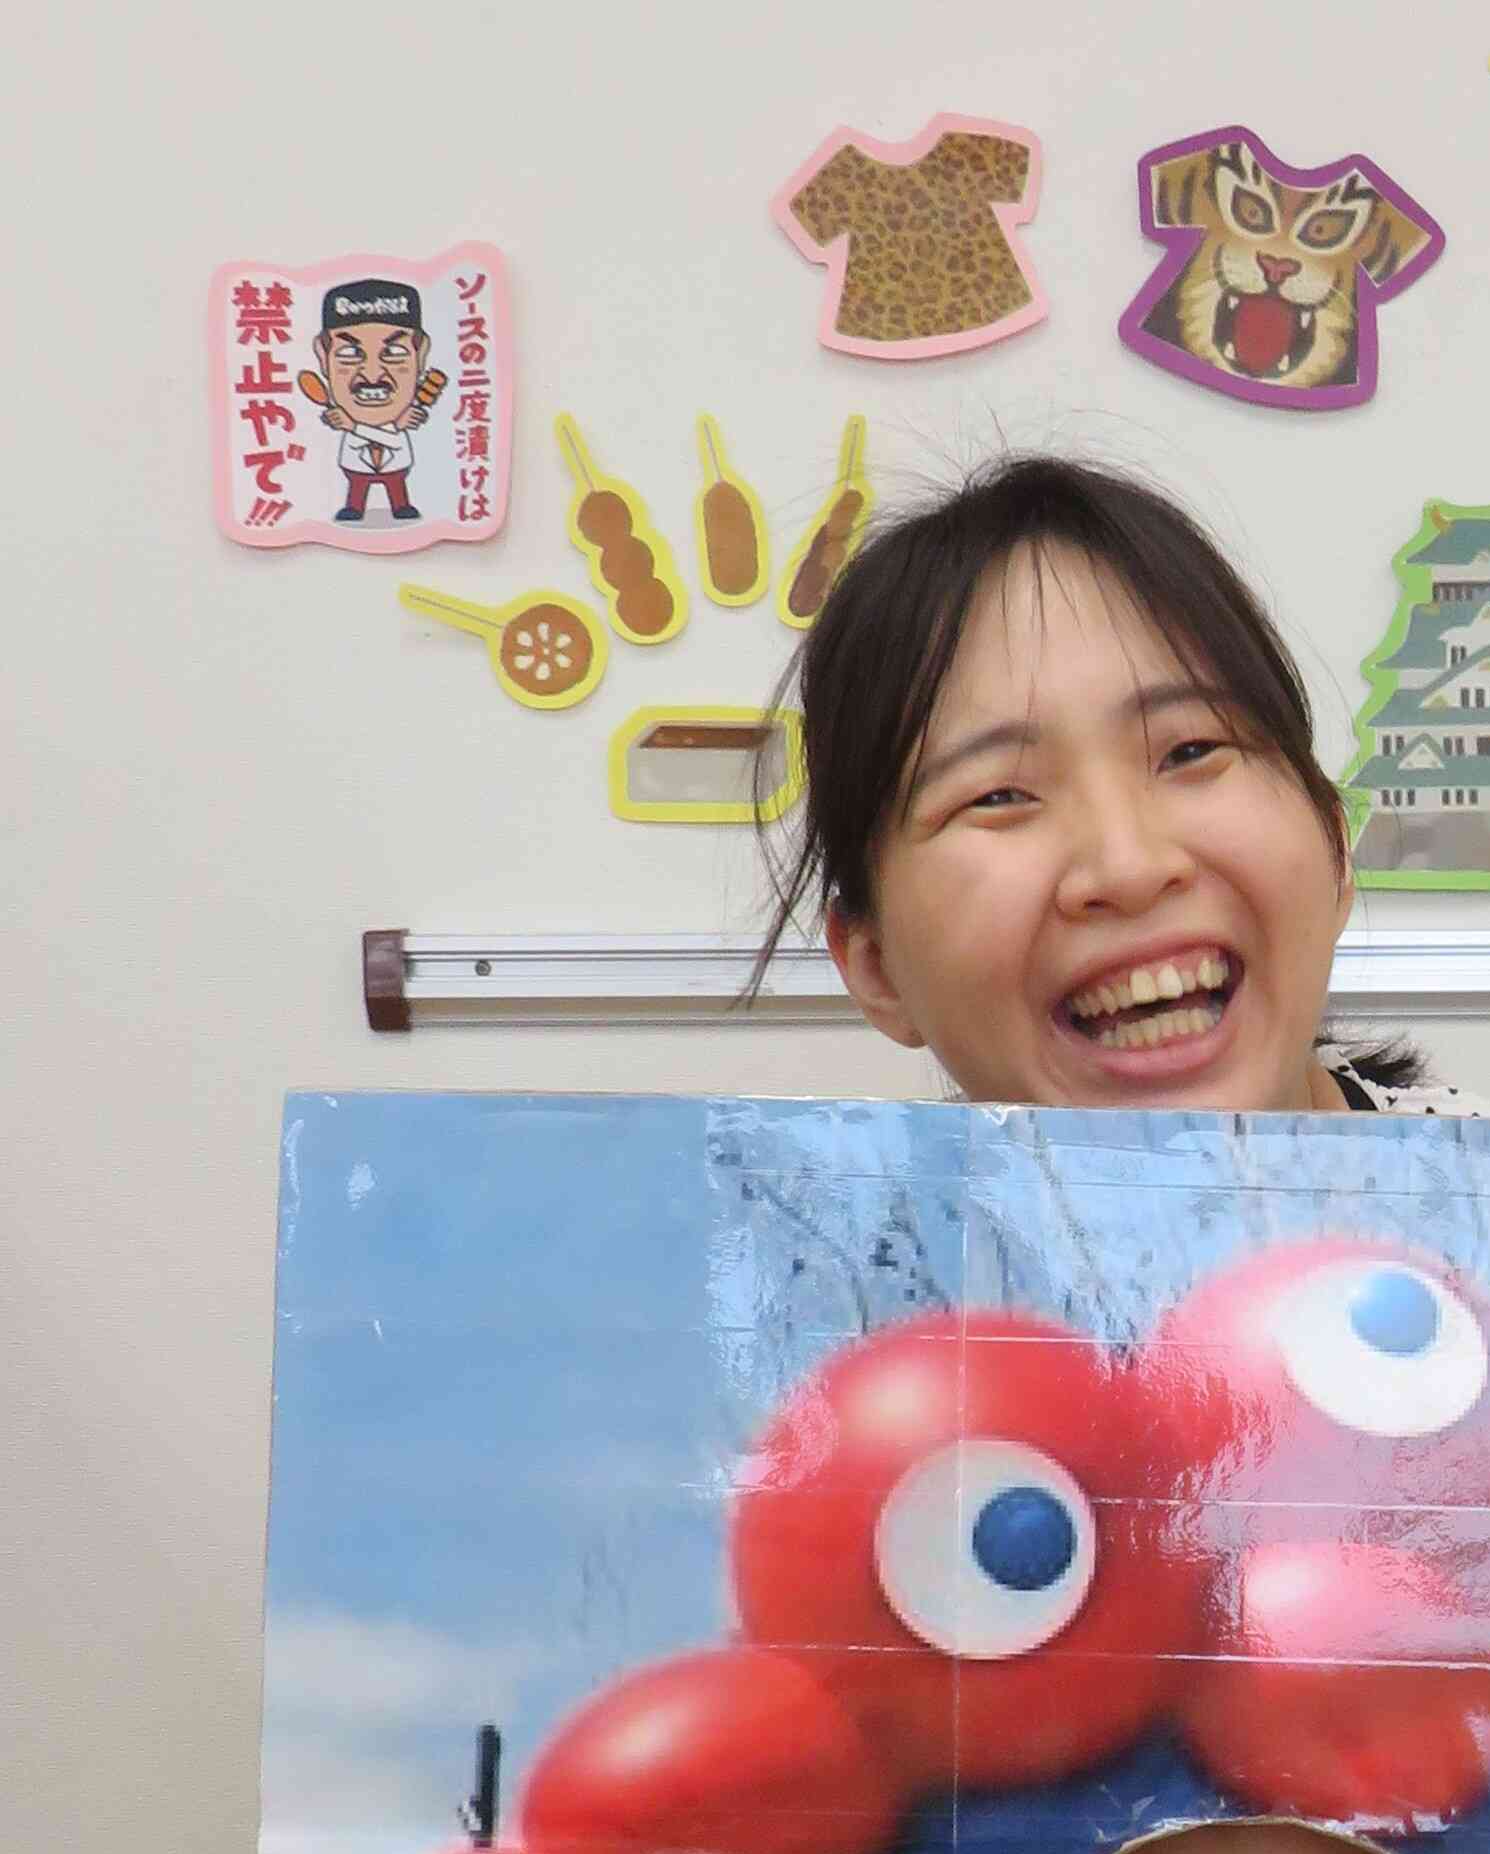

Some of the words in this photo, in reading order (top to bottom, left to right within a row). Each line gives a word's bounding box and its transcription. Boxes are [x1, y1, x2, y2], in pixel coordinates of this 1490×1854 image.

[453, 272, 492, 523] ソースの二度漬けは
